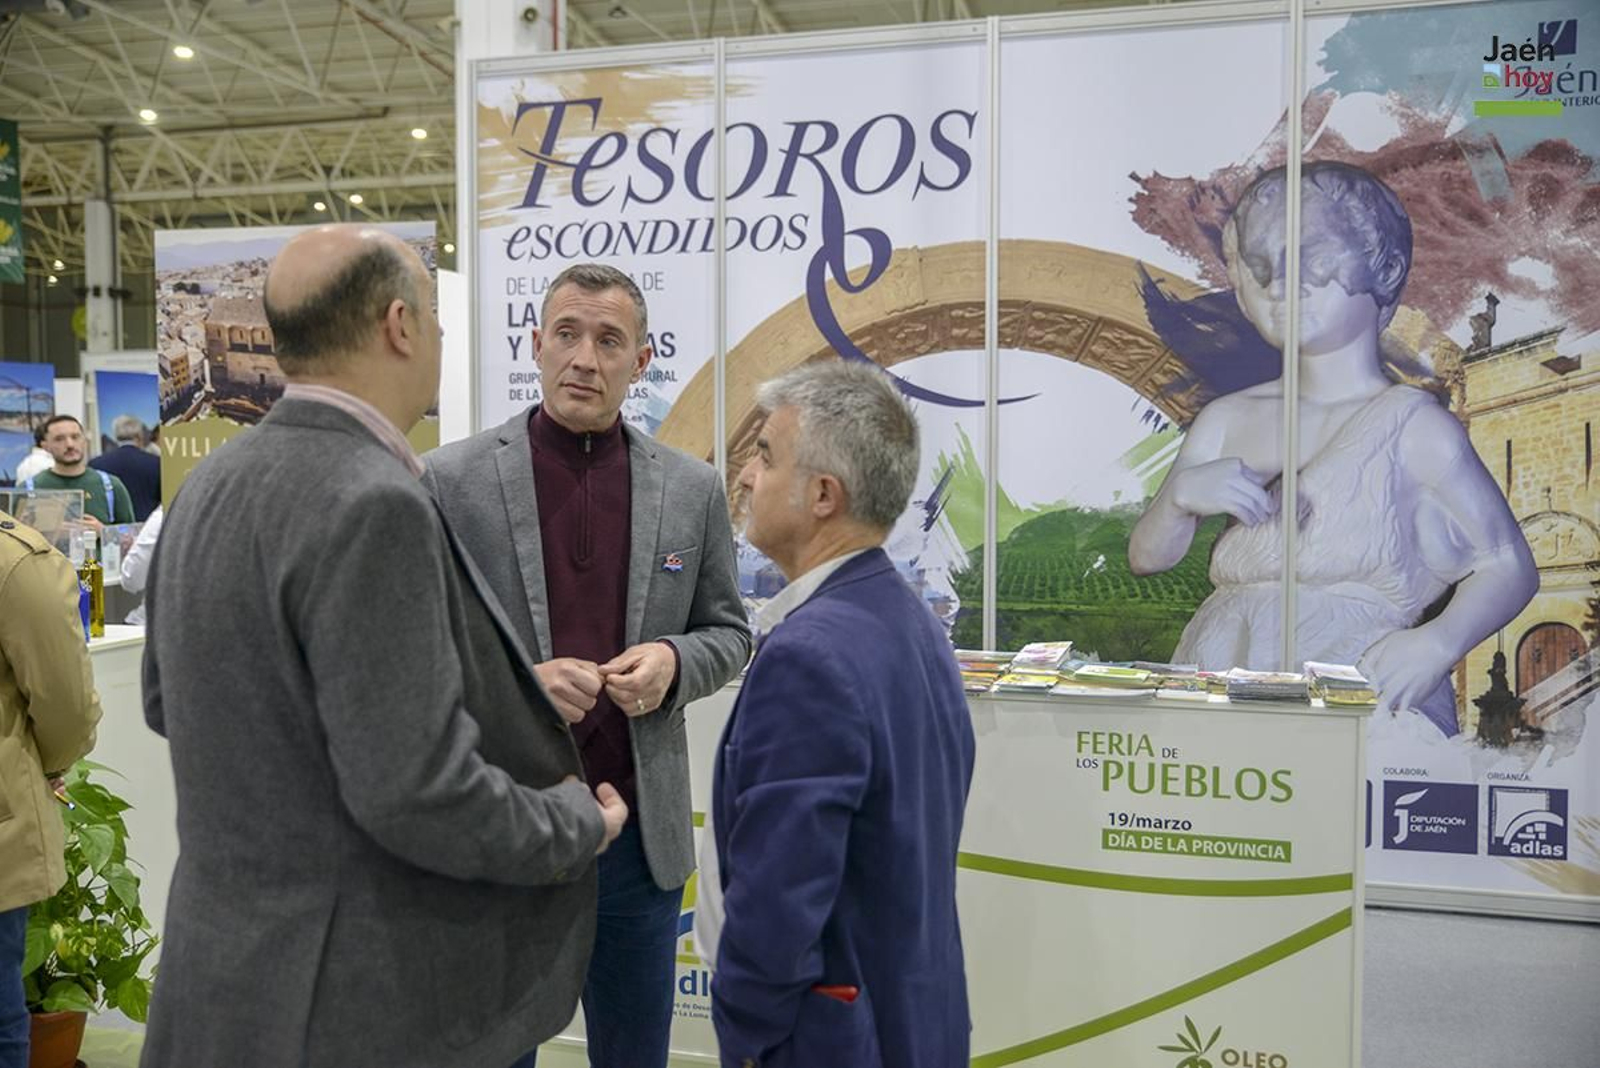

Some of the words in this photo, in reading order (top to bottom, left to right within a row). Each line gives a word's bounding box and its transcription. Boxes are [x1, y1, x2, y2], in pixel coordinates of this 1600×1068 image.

[507, 277, 527, 296] DE
[643, 272, 664, 291] DE
[508, 302, 538, 328] LA
[507, 335, 523, 361] Y
[509, 389, 524, 401] DE
[526, 389, 540, 401] LA
[628, 387, 649, 399] LAS
[1076, 731, 1155, 758] FERIA
[1162, 747, 1179, 760] DE
[1076, 758, 1099, 769] LOS
[1102, 759, 1293, 803] PUEBLOS
[1108, 812, 1192, 832] 19/marzo
[1410, 824, 1423, 833] DE
[1107, 831, 1137, 849] DÍA
[1141, 836, 1163, 850] DE
[1167, 839, 1188, 852] LA
[1192, 841, 1286, 860] PROVINCIA
[1510, 840, 1564, 857] adlas
[1221, 1048, 1288, 1068] OLEO
